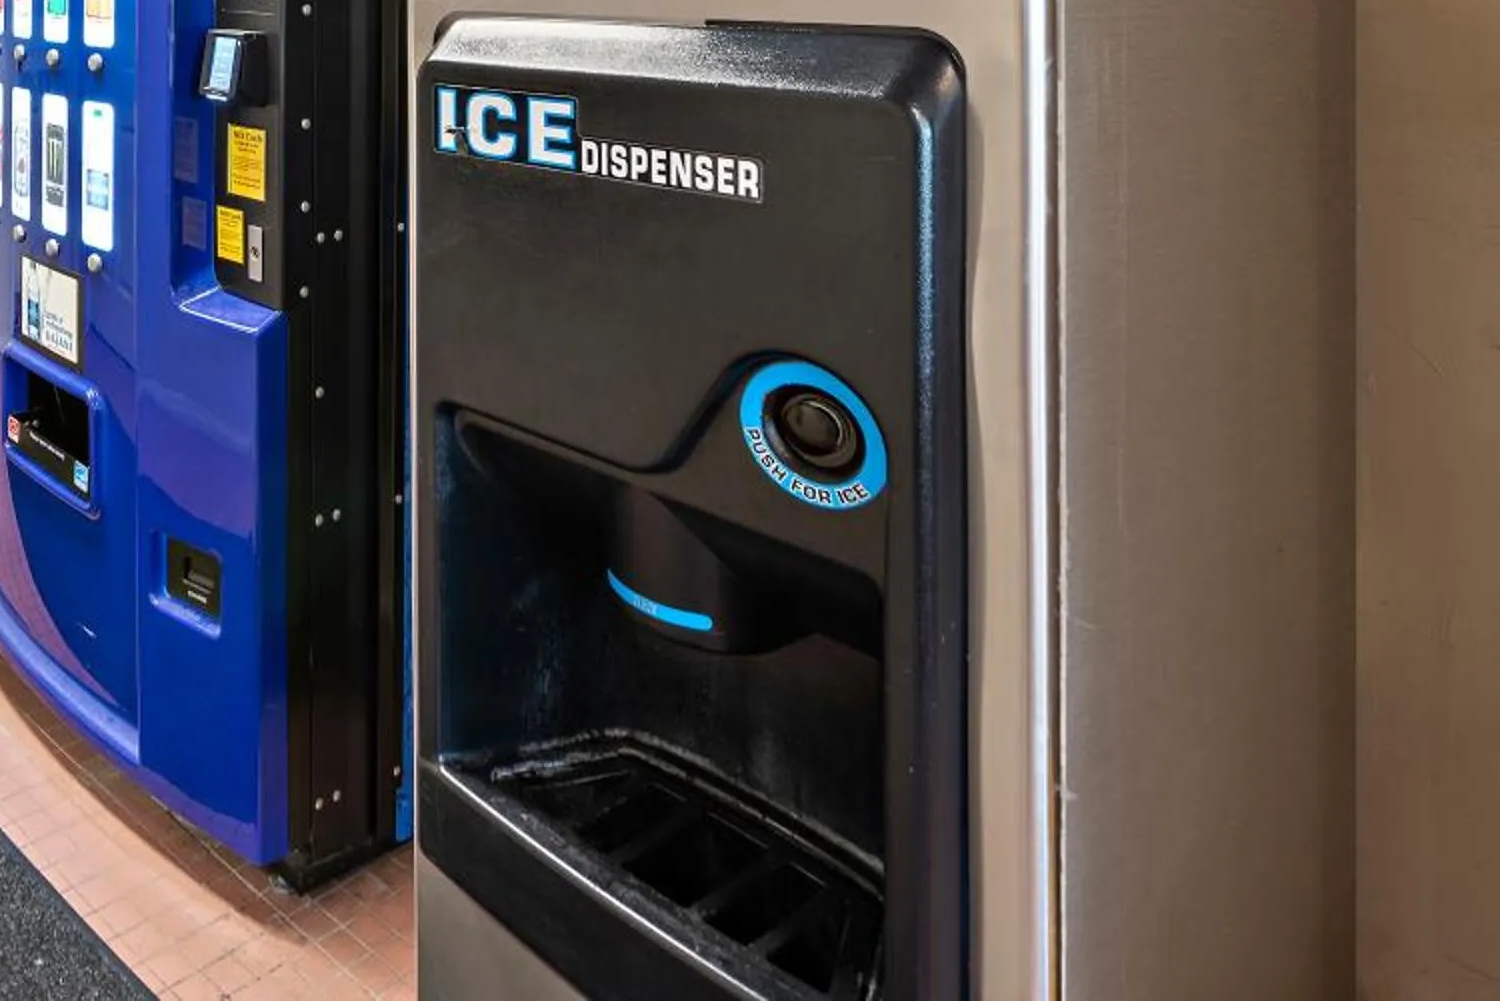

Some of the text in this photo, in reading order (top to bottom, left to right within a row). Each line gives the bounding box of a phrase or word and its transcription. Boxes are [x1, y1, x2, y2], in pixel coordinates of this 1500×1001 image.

[438, 86, 759, 198] ICE DISPENSER
[747, 428, 869, 504] PUSH FOR ICE
